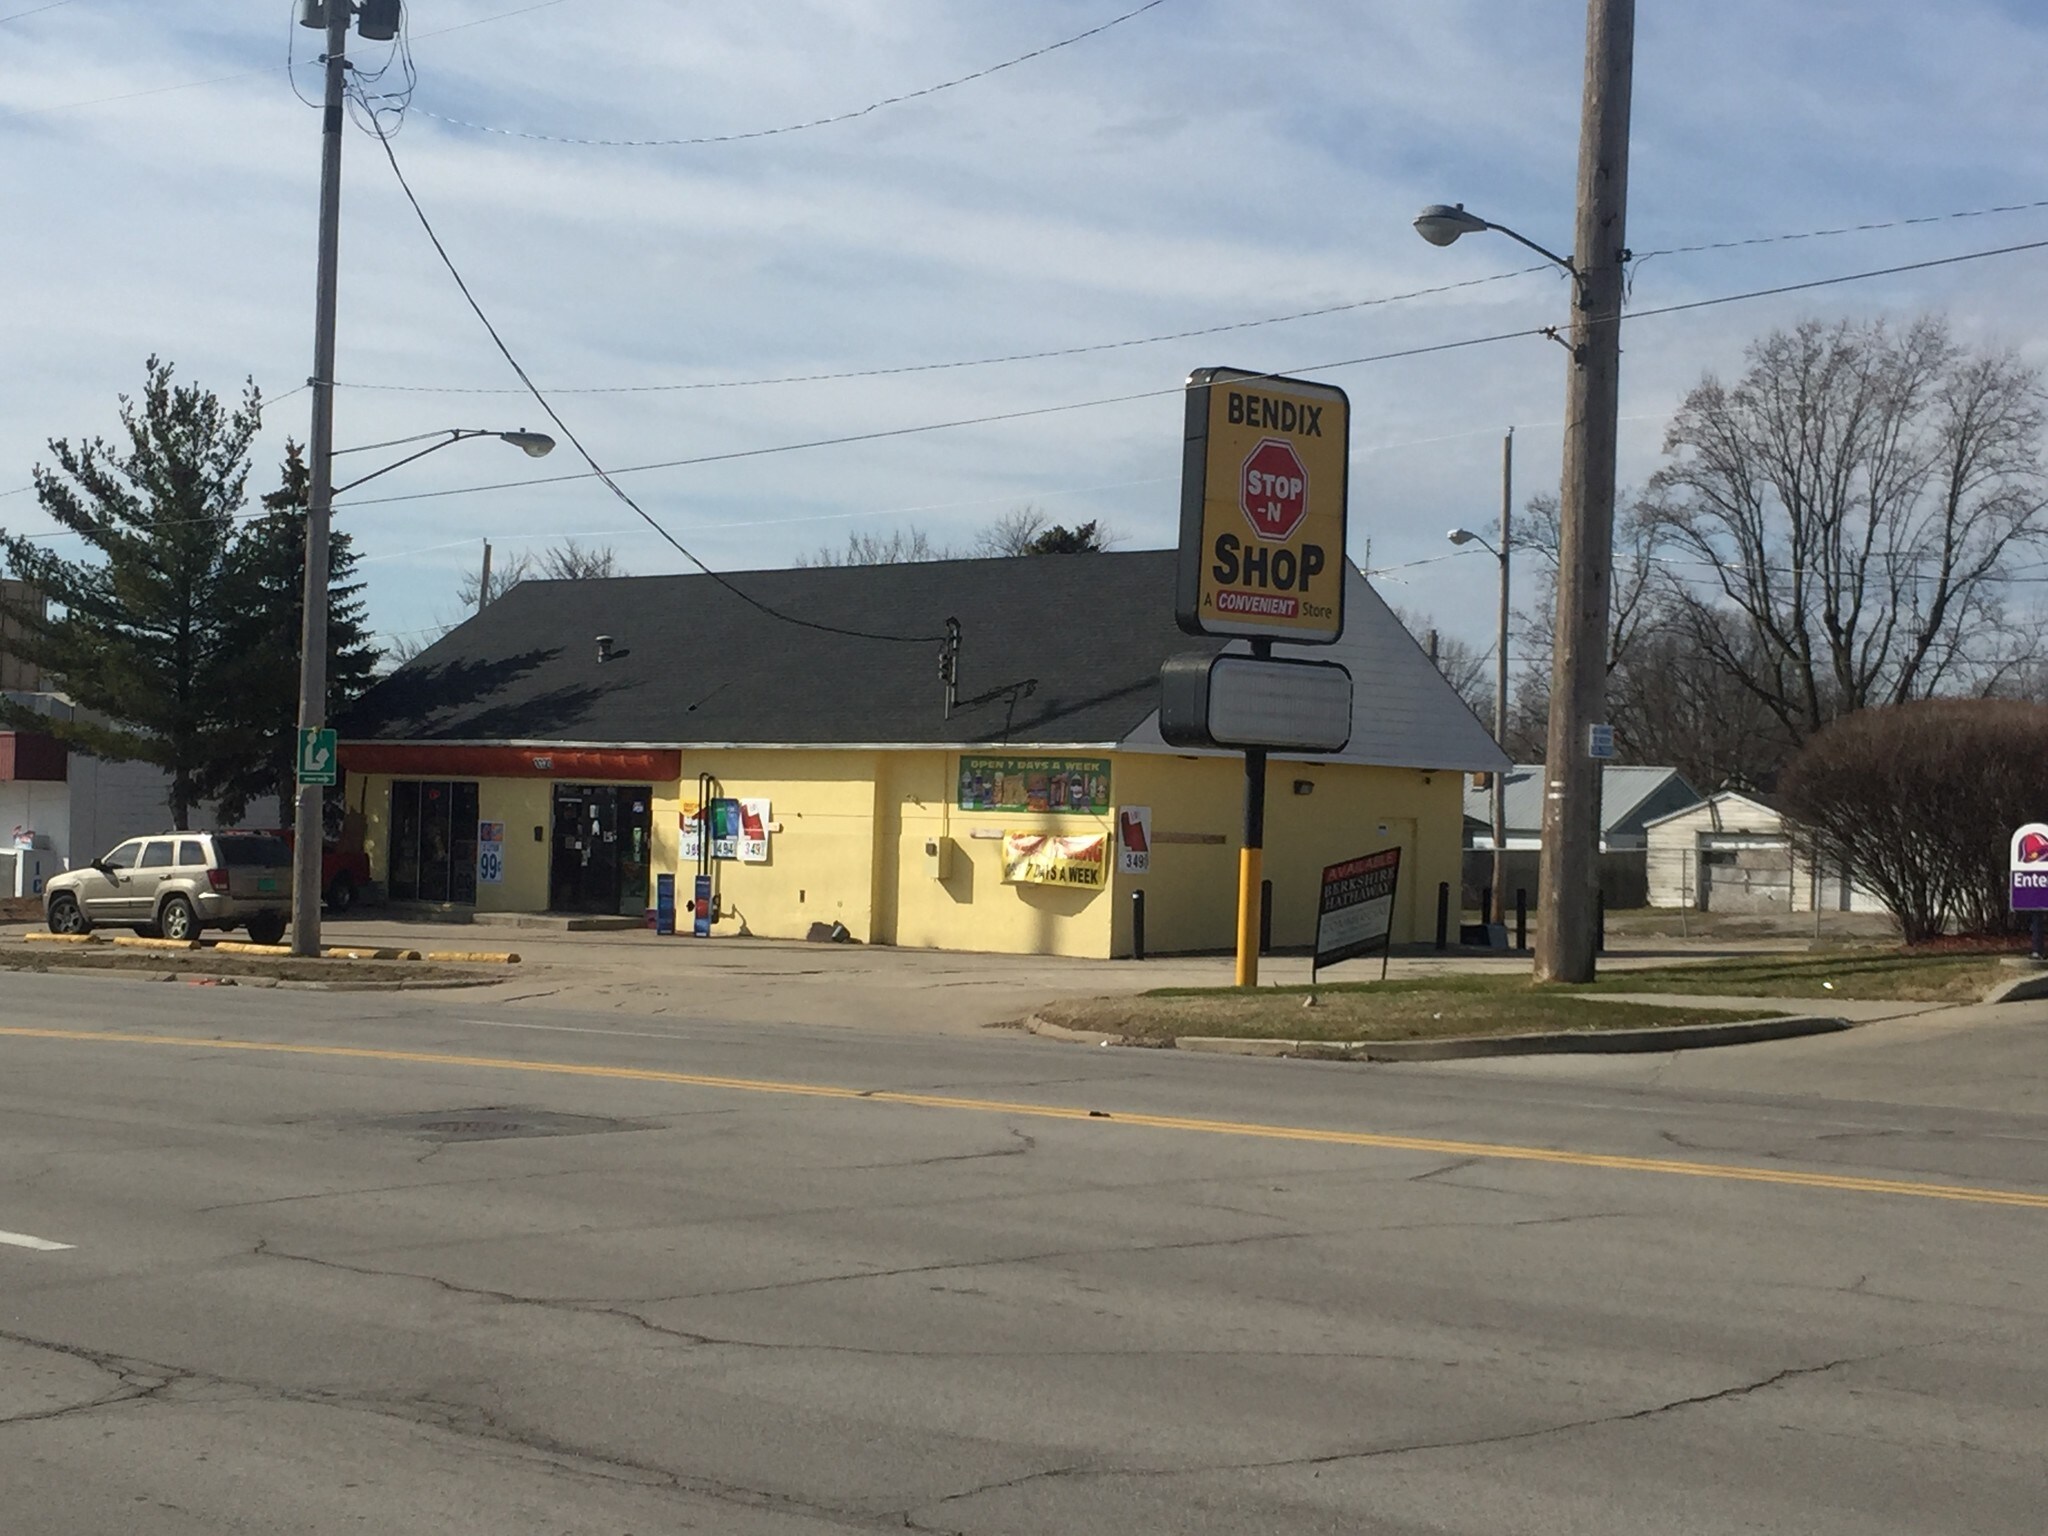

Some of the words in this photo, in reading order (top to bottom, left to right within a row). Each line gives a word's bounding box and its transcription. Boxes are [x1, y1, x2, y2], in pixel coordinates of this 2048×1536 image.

[1228, 391, 1323, 437] BENDIX
[1247, 469, 1302, 500] STOP
[1212, 533, 1325, 592] SHOP
[1203, 592, 1212, 607] A
[1218, 593, 1296, 616] CONVENIENT
[1302, 602, 1332, 619] Store
[970, 760, 1004, 769] OPEN
[1007, 760, 1014, 769] 7
[1017, 760, 1049, 770] DAYS
[1051, 761, 1061, 770] A
[1065, 761, 1100, 771] WEEK
[1025, 862, 1033, 877] 7
[1059, 867, 1067, 882] A
[1068, 867, 1099, 885] WEEK
[1126, 853, 1145, 869] 349
[1324, 867, 1395, 898] BERKSHIRE
[2014, 872, 2048, 888] Ente
[1324, 880, 1392, 910] HATHAWAY
